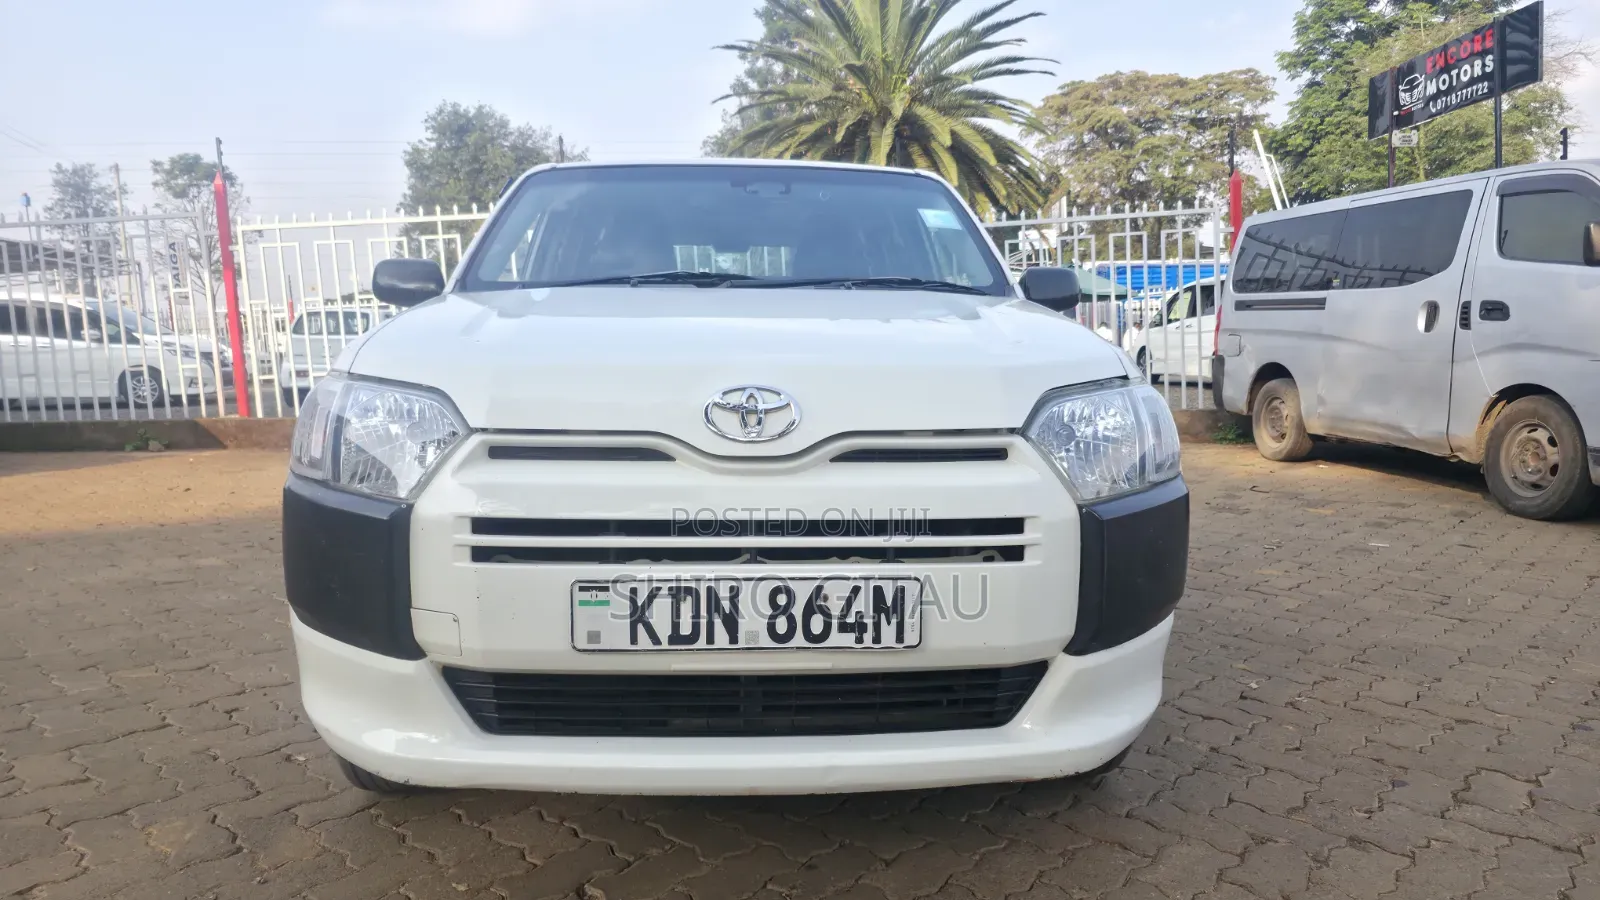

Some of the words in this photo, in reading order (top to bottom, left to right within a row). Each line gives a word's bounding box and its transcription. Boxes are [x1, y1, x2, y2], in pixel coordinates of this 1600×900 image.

[1426, 28, 1494, 74] ENCORE
[1426, 54, 1494, 96] MOTORS
[1436, 81, 1488, 110] 0718777722
[629, 585, 739, 646] KDN
[766, 585, 905, 647] 864M
